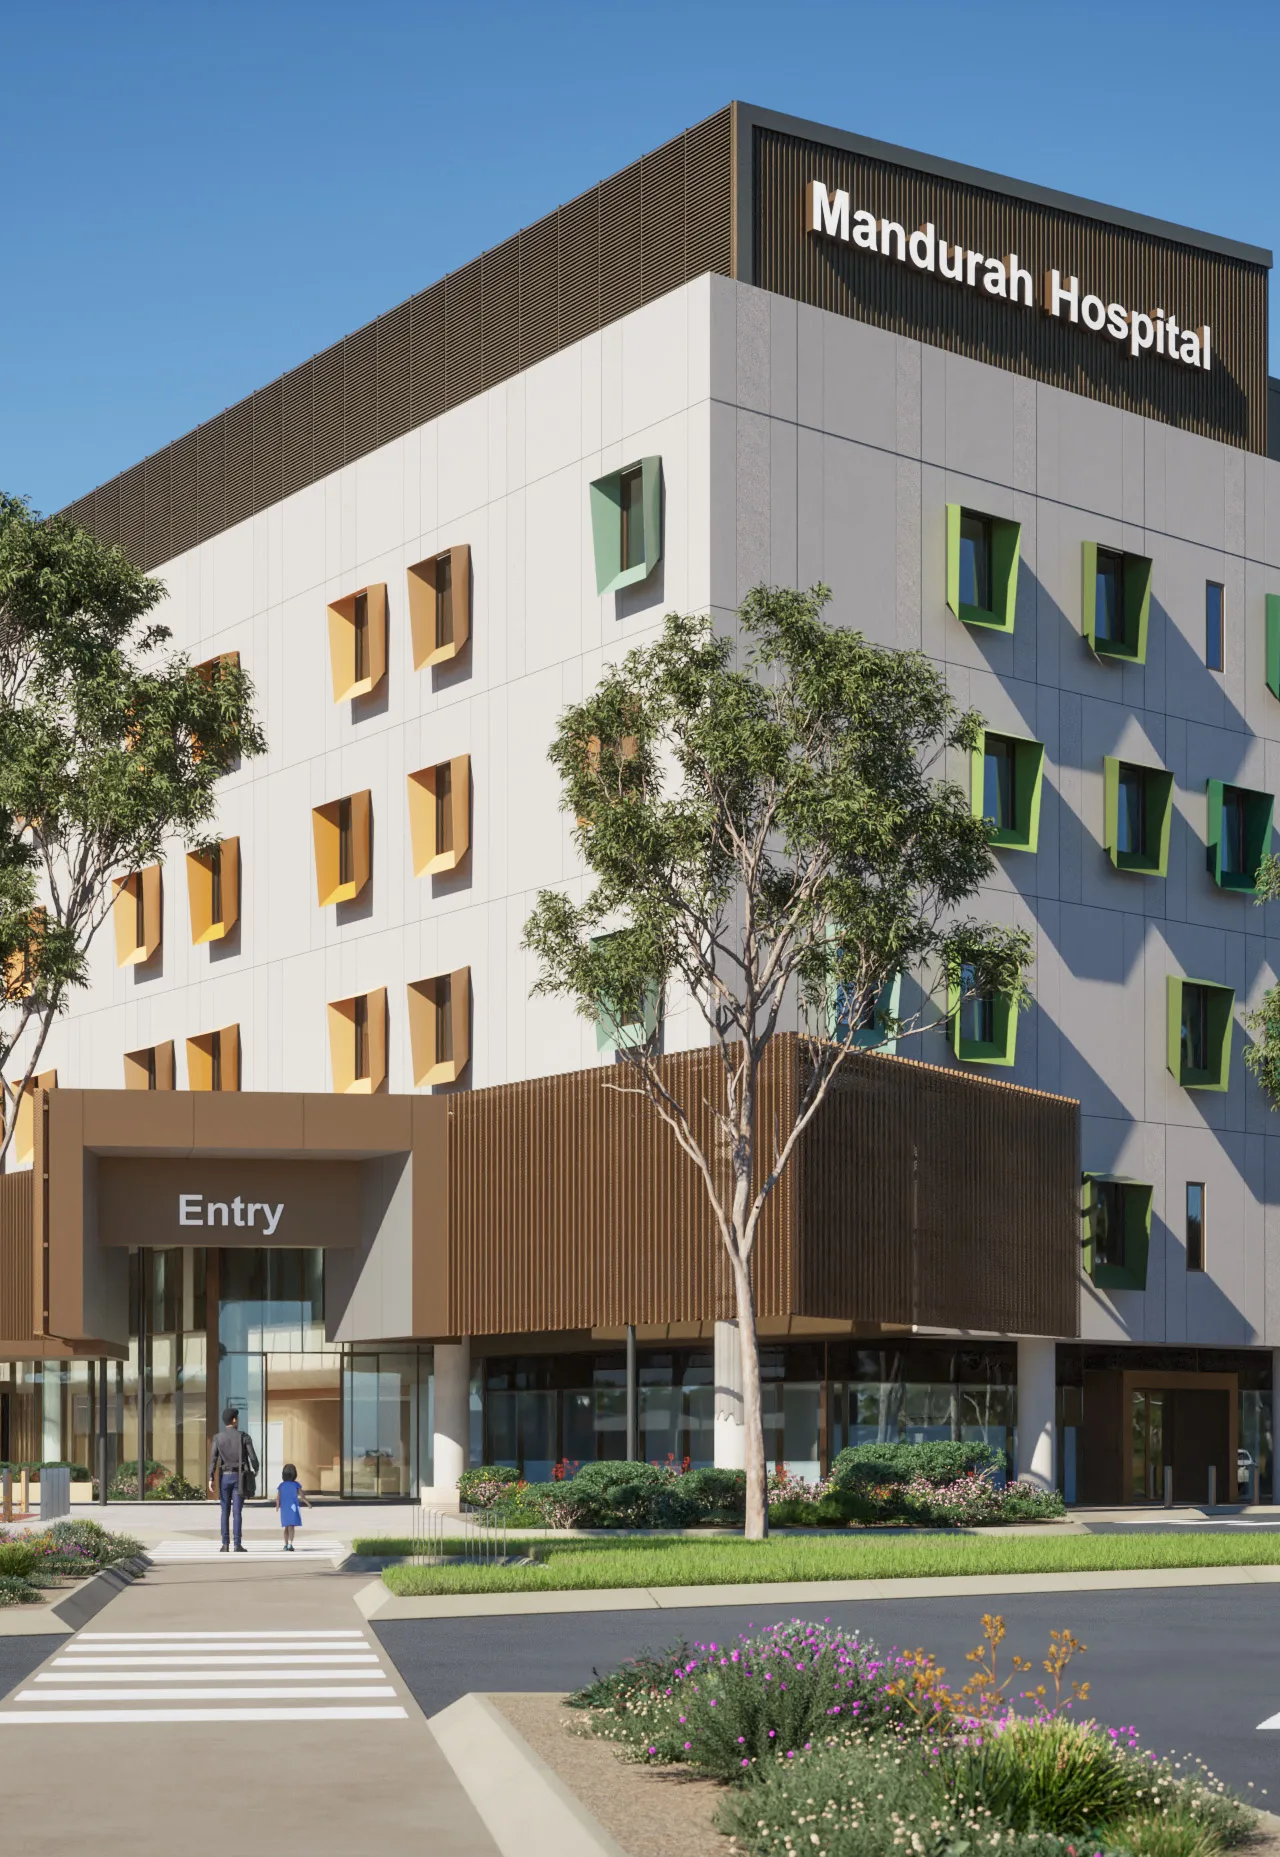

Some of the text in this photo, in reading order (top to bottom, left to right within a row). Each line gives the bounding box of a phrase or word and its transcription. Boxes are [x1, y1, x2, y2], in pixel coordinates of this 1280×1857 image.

[813, 180, 1211, 370] Mandurah Hospital
[179, 1194, 285, 1235] Entry
